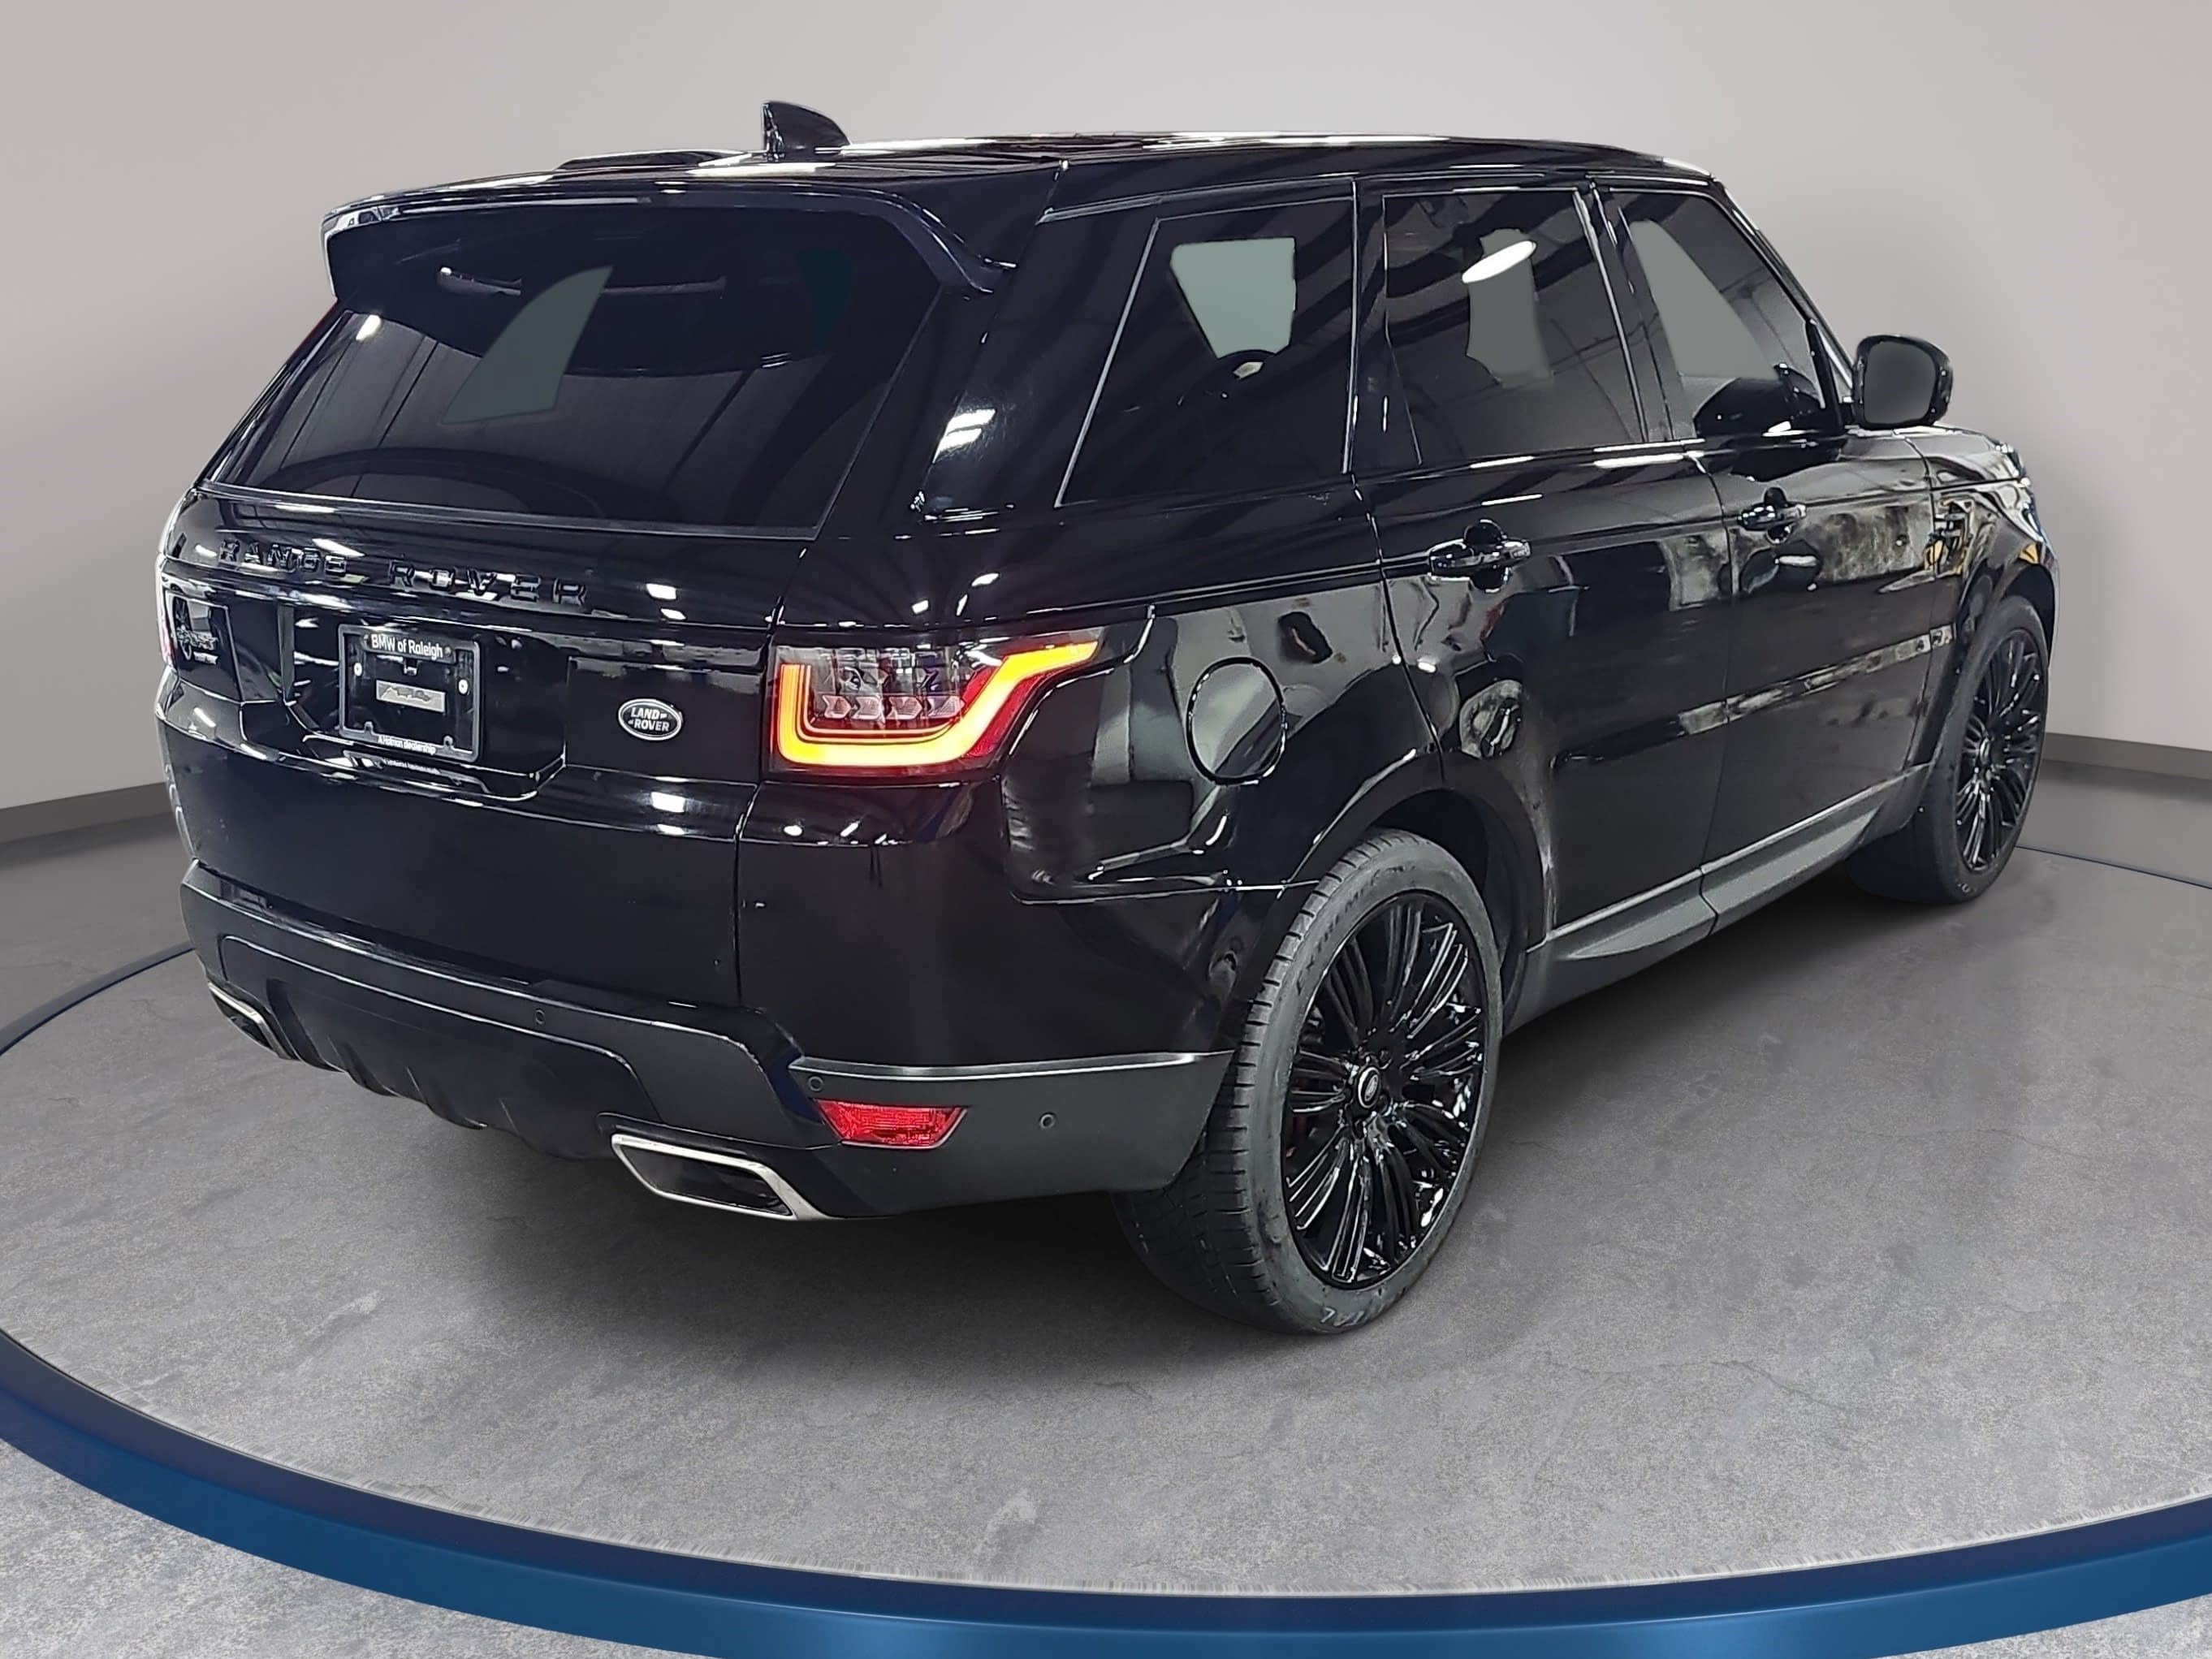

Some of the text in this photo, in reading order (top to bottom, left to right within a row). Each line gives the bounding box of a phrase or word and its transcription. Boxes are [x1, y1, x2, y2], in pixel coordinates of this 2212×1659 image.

[218, 538, 588, 607] RANGE ROVER
[370, 633, 443, 660] BMW of Raleigh
[630, 706, 660, 719] LAND
[633, 718, 670, 732] ROVER
